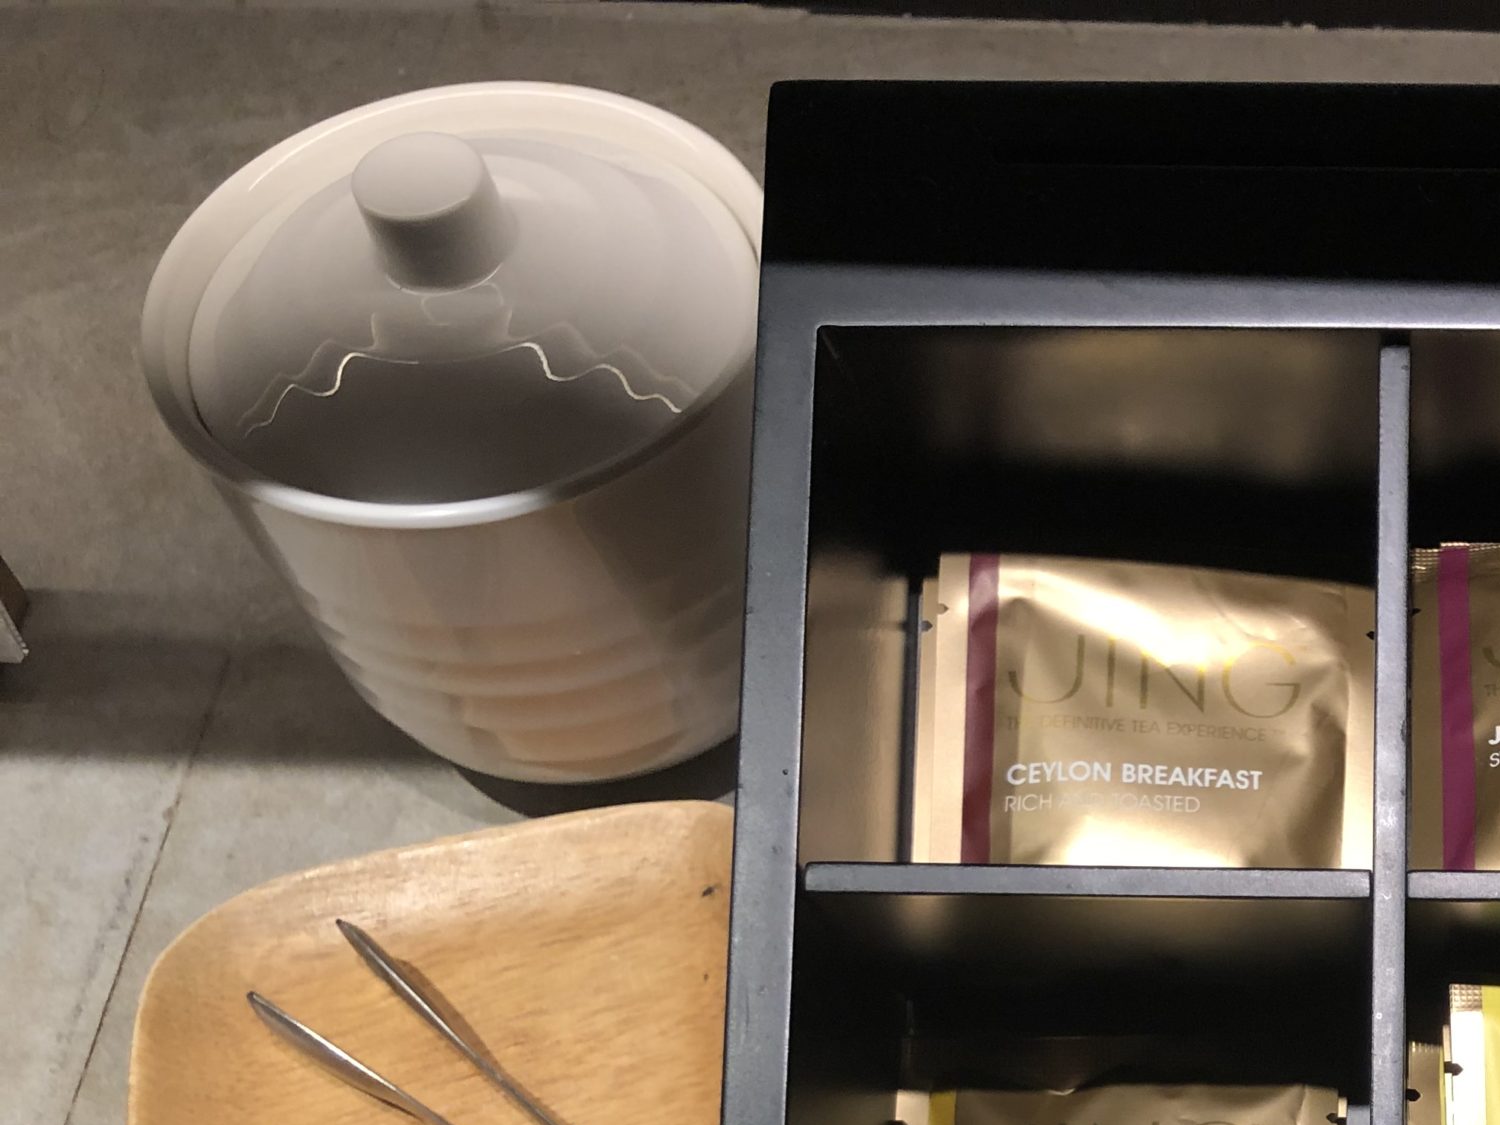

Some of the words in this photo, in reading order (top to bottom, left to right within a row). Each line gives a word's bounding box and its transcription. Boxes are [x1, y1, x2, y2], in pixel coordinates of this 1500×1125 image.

[1008, 633, 1300, 719] JING
[1006, 715, 1036, 733] TH
[1132, 718, 1161, 735] TEA
[1166, 720, 1267, 742] EXPERIENCE
[1006, 759, 1112, 787] CEYLON
[1121, 762, 1264, 791] BREAKFAST
[1004, 793, 1053, 814] RICH
[1111, 792, 1201, 814] TOASTED
